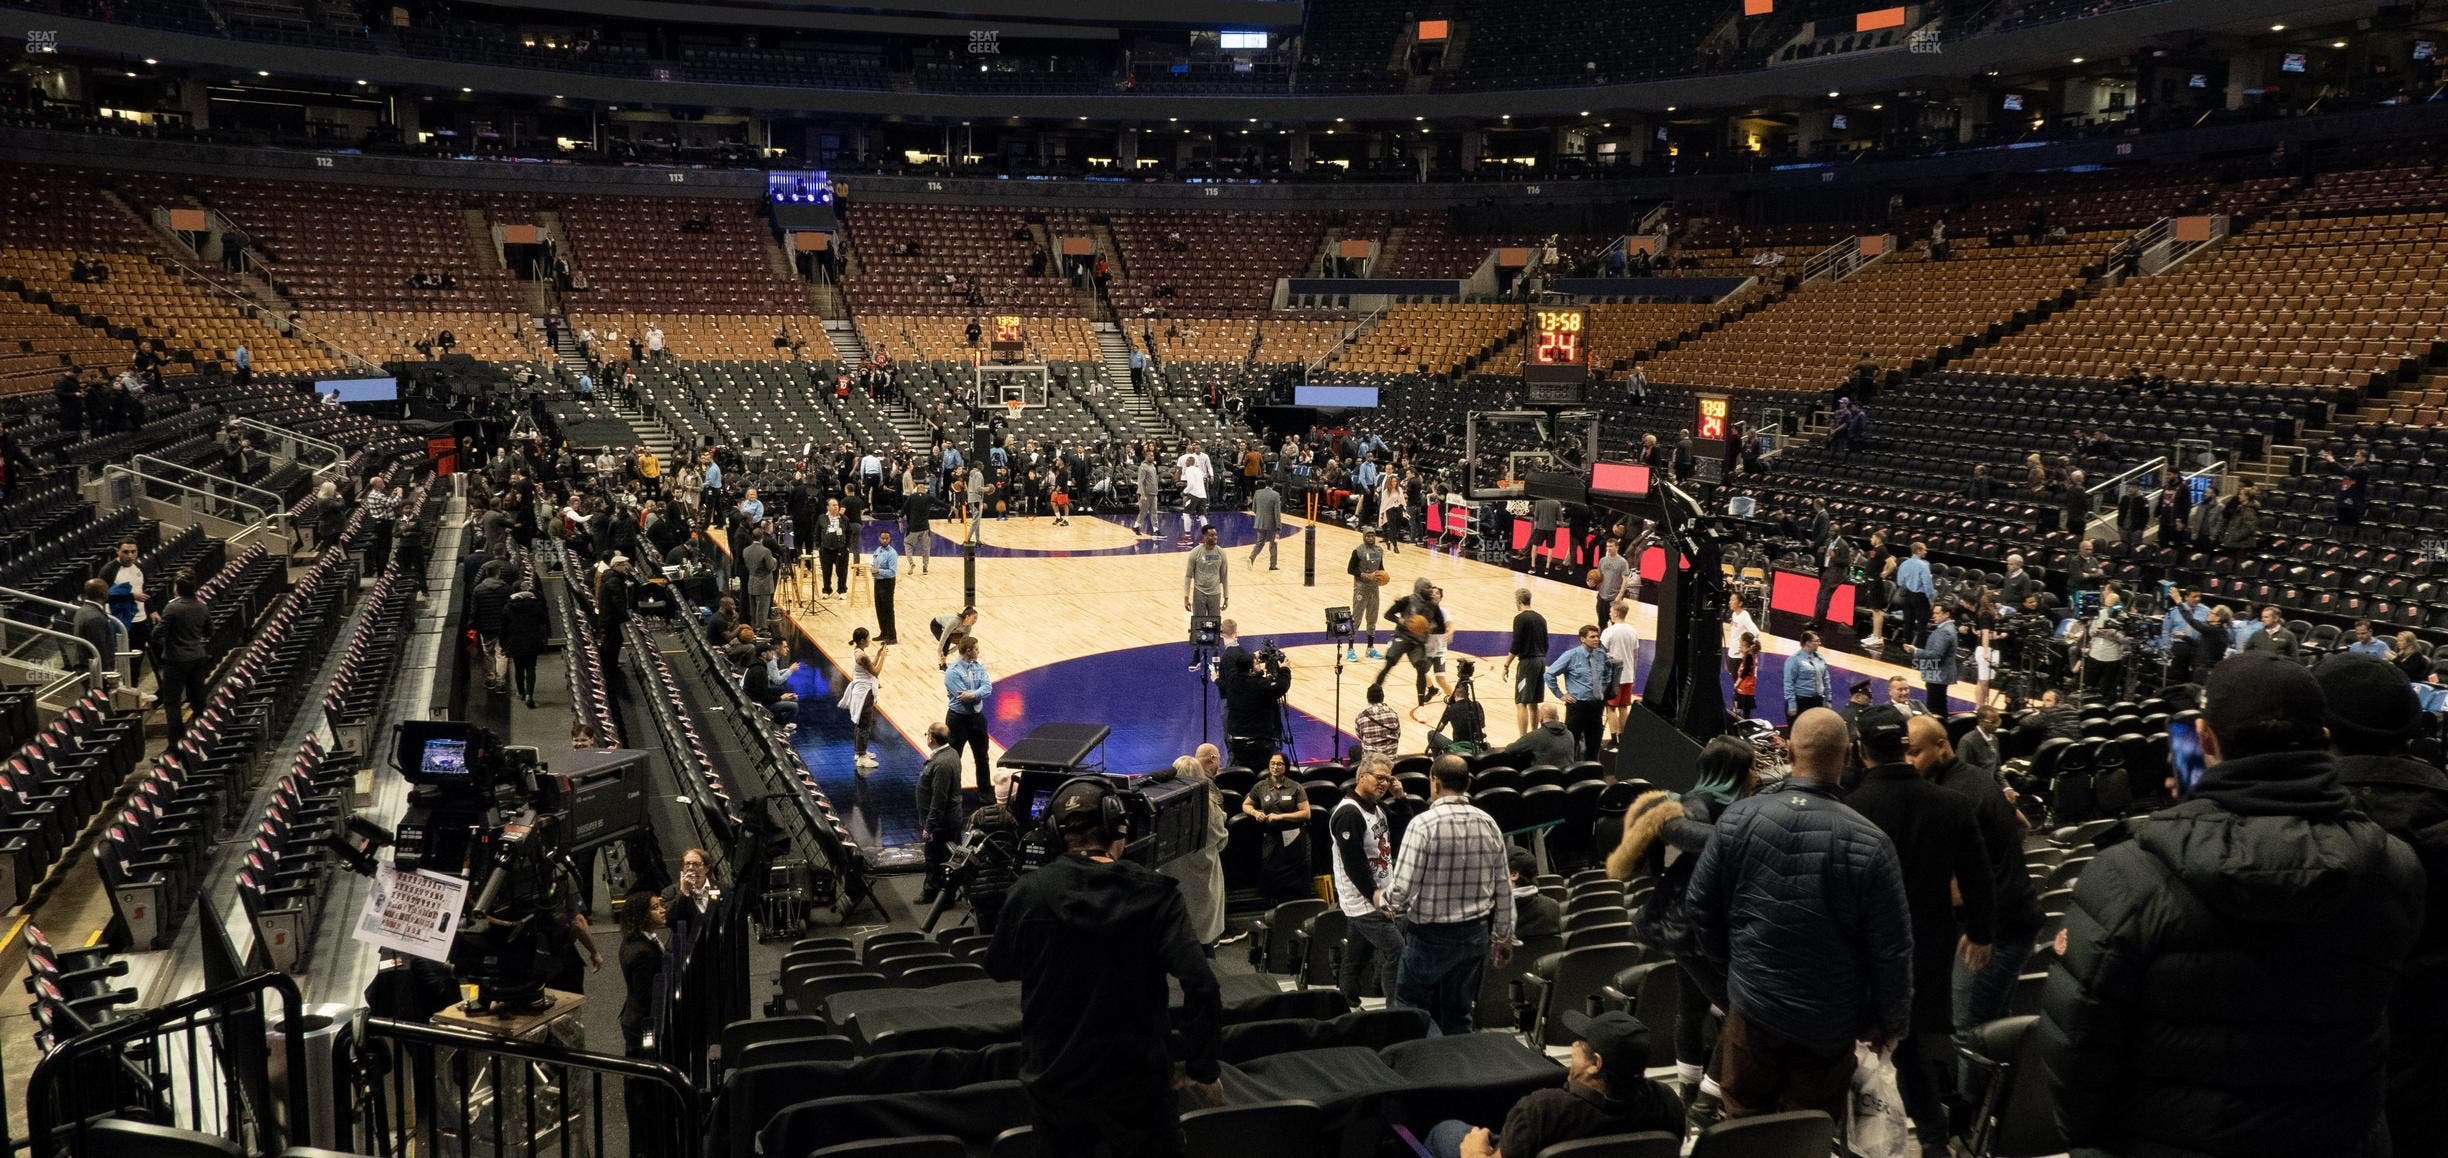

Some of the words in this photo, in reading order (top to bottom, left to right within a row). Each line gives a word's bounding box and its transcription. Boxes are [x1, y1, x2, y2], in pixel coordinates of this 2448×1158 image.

[2116, 143, 2132, 155] 118
[315, 157, 334, 168] 112
[668, 173, 685, 183] 113
[1821, 172, 1835, 182] 117
[927, 181, 943, 191] 114
[1526, 185, 1541, 195] 116
[1204, 187, 1219, 197] 115
[1537, 311, 1582, 331] 73:58
[998, 327, 1017, 341] 24
[1537, 332, 1576, 363] 24
[1703, 416, 1721, 436] 24
